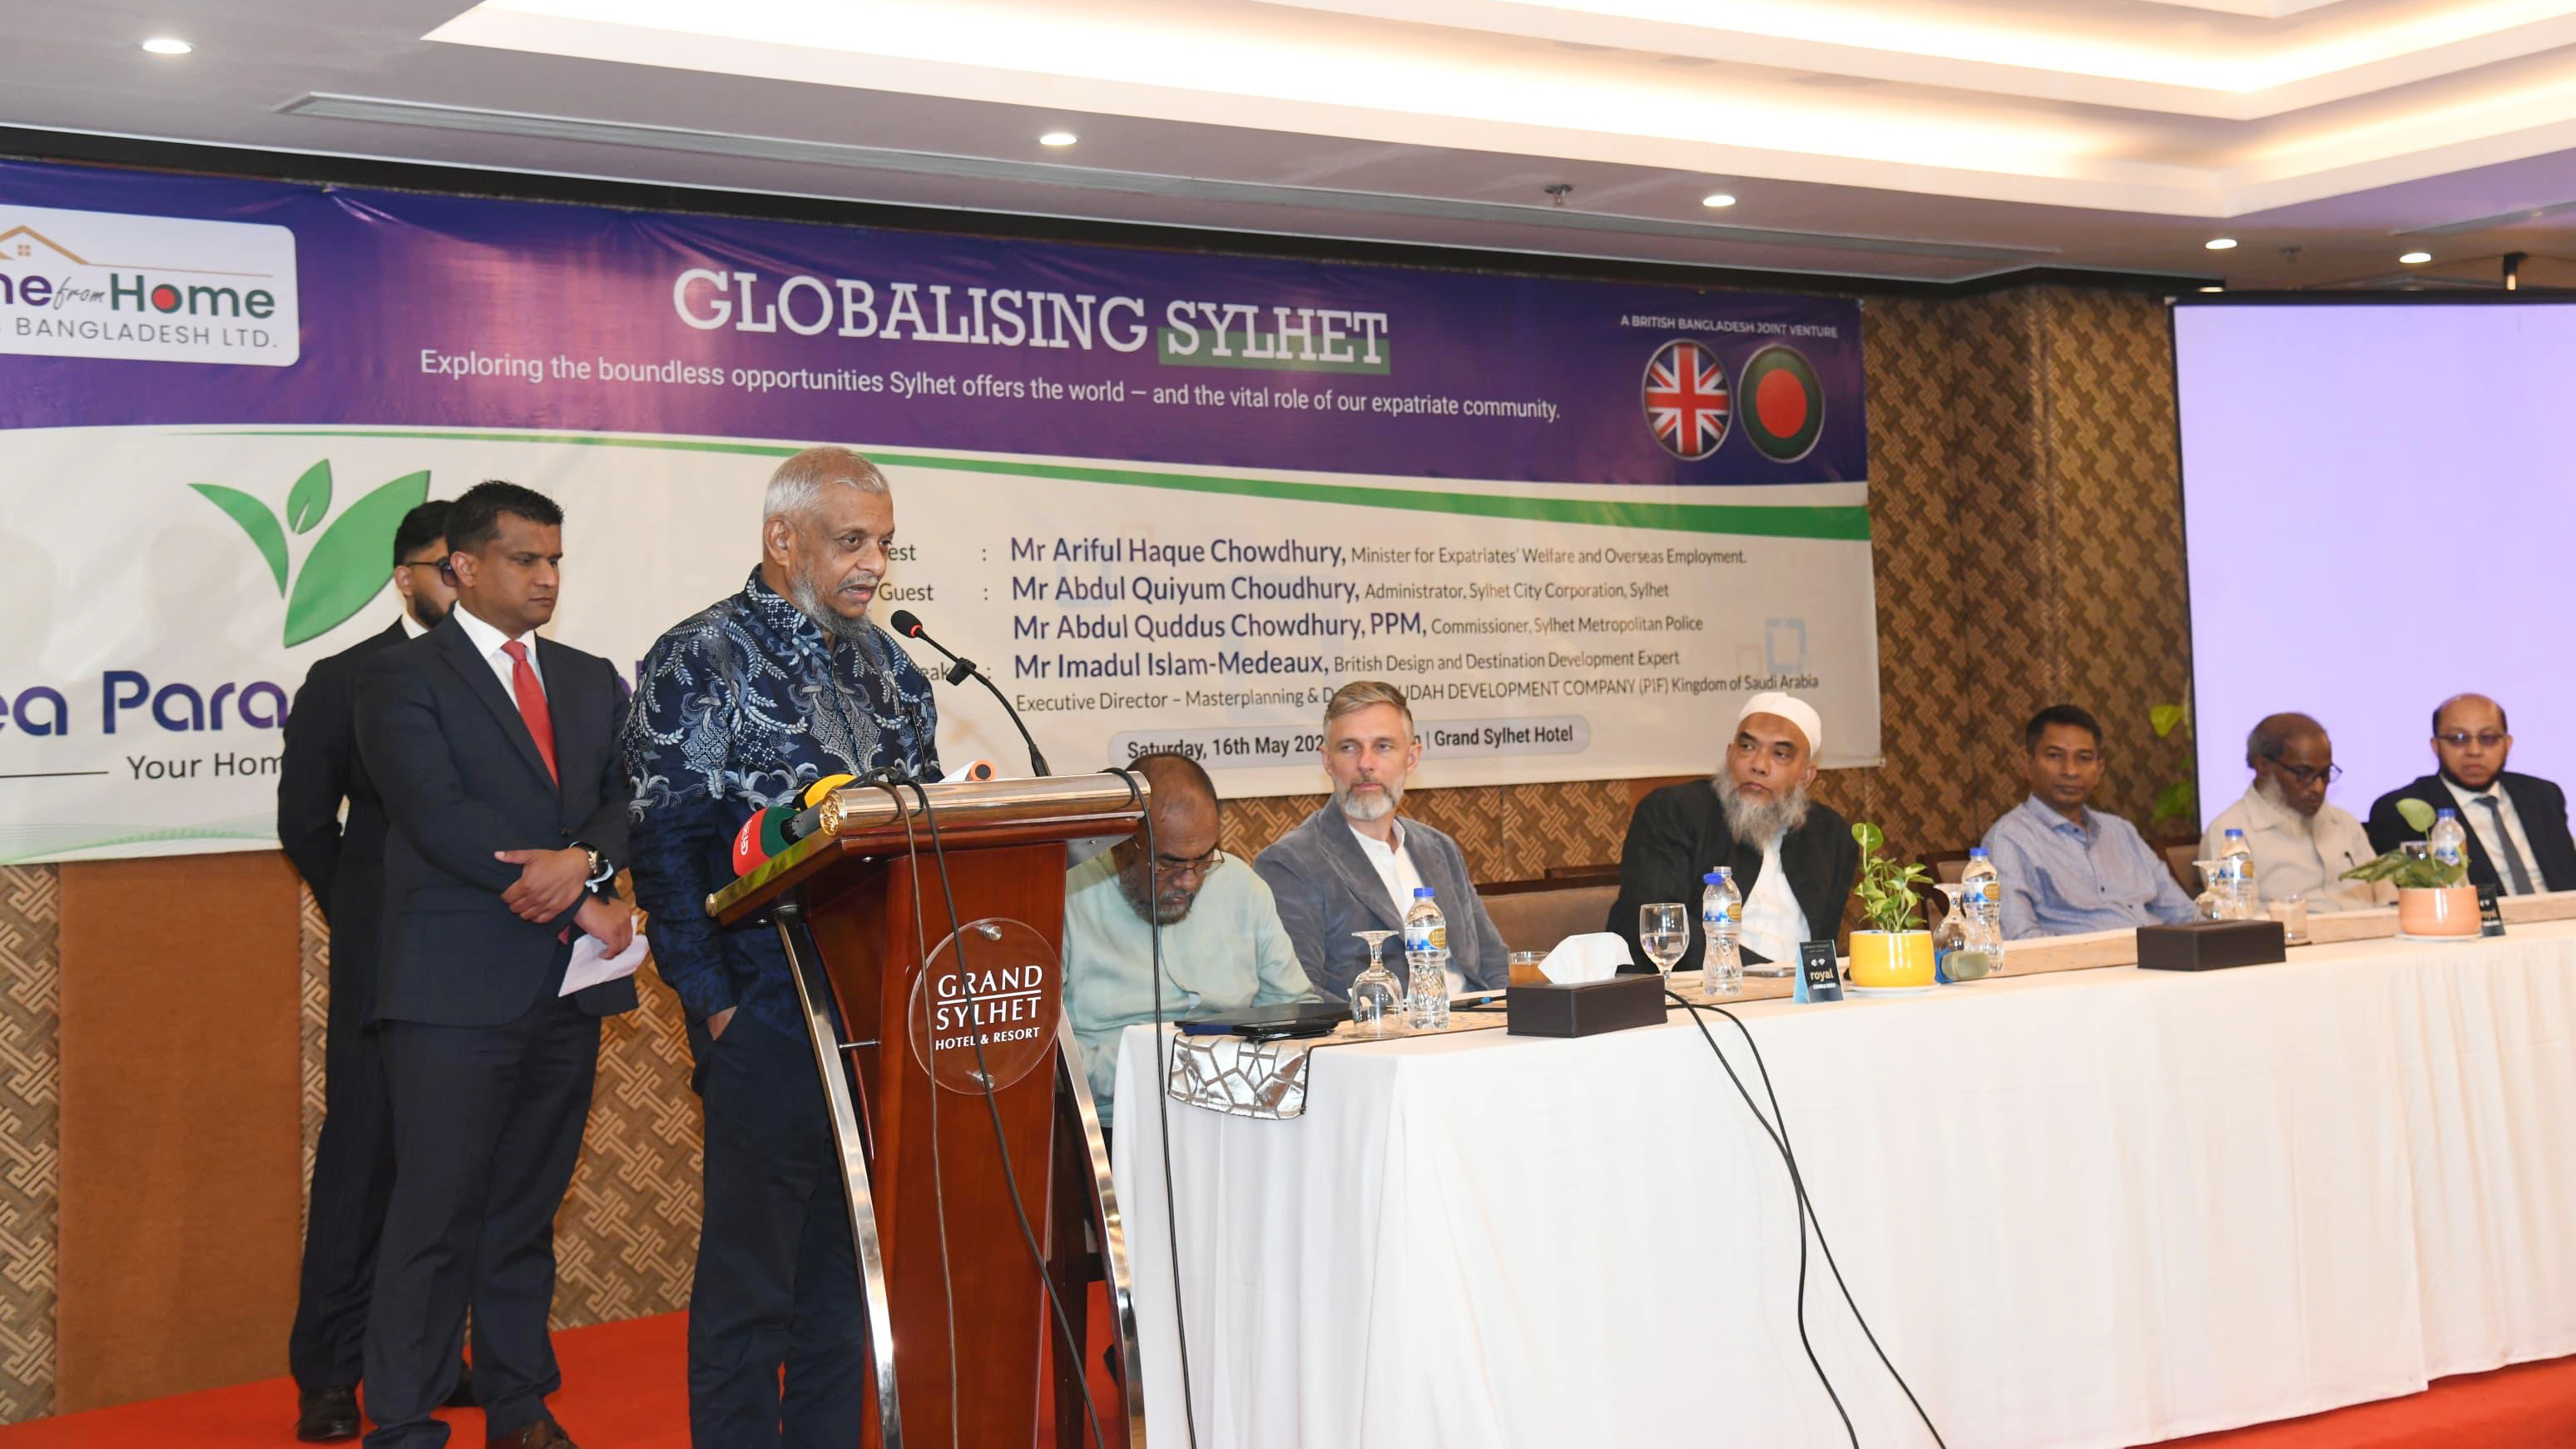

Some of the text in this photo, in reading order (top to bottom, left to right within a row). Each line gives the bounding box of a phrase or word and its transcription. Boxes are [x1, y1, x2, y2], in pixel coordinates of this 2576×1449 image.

[52, 276, 106, 310] from
[110, 273, 275, 319] Home
[673, 268, 1388, 365] GLOBALISING SYLHET
[1620, 315, 1837, 338] A BRITISH BANGLADESH JOINT VENTURE
[16, 317, 277, 348] BANGLADESH LTD.
[420, 350, 544, 384] Exploring
[552, 355, 591, 380] the
[598, 357, 724, 385] boundless
[731, 368, 884, 392] opportunities
[890, 370, 956, 399] Sylhet
[963, 375, 1024, 398] offers
[1029, 376, 1063, 400] the
[1068, 380, 1124, 402] world
[1152, 384, 1189, 404] and
[1194, 385, 1225, 406] the
[1230, 386, 1269, 408] vital
[1275, 389, 1309, 409] role
[1314, 390, 1332, 410] of
[1337, 395, 1366, 411] our
[1372, 394, 1458, 417] expatriate
[1463, 399, 1560, 422] community.
[887, 543, 917, 561] est
[1011, 538, 1046, 562] Mr
[1053, 538, 1122, 562] Ariful
[1129, 538, 1205, 567] Haque
[1211, 539, 1346, 568] Chowdhury,
[1351, 547, 1410, 563] Minister
[1415, 547, 1434, 563] for
[1522, 548, 1574, 564] Welfare
[1578, 548, 1602, 563] and
[1605, 548, 1663, 564] Overseas
[1667, 548, 1746, 567] Employment.
[879, 583, 934, 601] Guest
[1013, 577, 1048, 600] Mr
[1055, 576, 1125, 600] Abdul
[1132, 576, 1226, 605] Quiyum
[1231, 577, 1360, 603] Choudhury,
[1365, 583, 1467, 600] Administrator,
[1469, 583, 1510, 602] Sylhet
[1514, 583, 1542, 600] City
[1545, 583, 1627, 601] Corporation,
[1630, 582, 1669, 600] Sylhet
[1013, 612, 1704, 642] Mr Abdul Quddus Chowdhury, PPM, Commissioner, Sylhet Metropolitan Police
[1014, 654, 1050, 678] Mr
[1058, 653, 1140, 677] Imadul
[1147, 652, 1329, 677] Islam-Medeaux,
[1335, 655, 1382, 672] British
[1386, 654, 1434, 673] Design
[1438, 653, 1463, 670] and
[1466, 653, 1545, 669] Destination
[1549, 651, 1634, 668] Development
[1638, 650, 1680, 667] Expert
[1017, 693, 1096, 712] Executive
[1100, 691, 1168, 711] Director
[1186, 689, 1304, 708] Masterplanning
[1307, 689, 1319, 703] &
[1449, 681, 1561, 700] DEVELOPMENT
[1563, 678, 1636, 697] COMPANY
[1639, 677, 1668, 697] (PIF)
[1672, 676, 1726, 696] Kingdom
[1729, 675, 1741, 691] of
[1744, 674, 1777, 691] Saudi
[1780, 673, 1819, 690] Arabia
[102, 670, 289, 735] Para
[1212, 737, 1249, 756] 16th
[1256, 736, 1290, 758] May
[1295, 734, 1325, 752] 202
[1434, 728, 1479, 747] Grand
[1484, 727, 1530, 749] Sylhet
[1535, 724, 1573, 742] Hotel
[126, 752, 282, 780] Your Hom
[938, 965, 1043, 998] GRAND
[1810, 967, 1835, 982] royal
[936, 996, 1042, 1030] SYLHET
[935, 1026, 1040, 1050] HOTEL & RESORT
